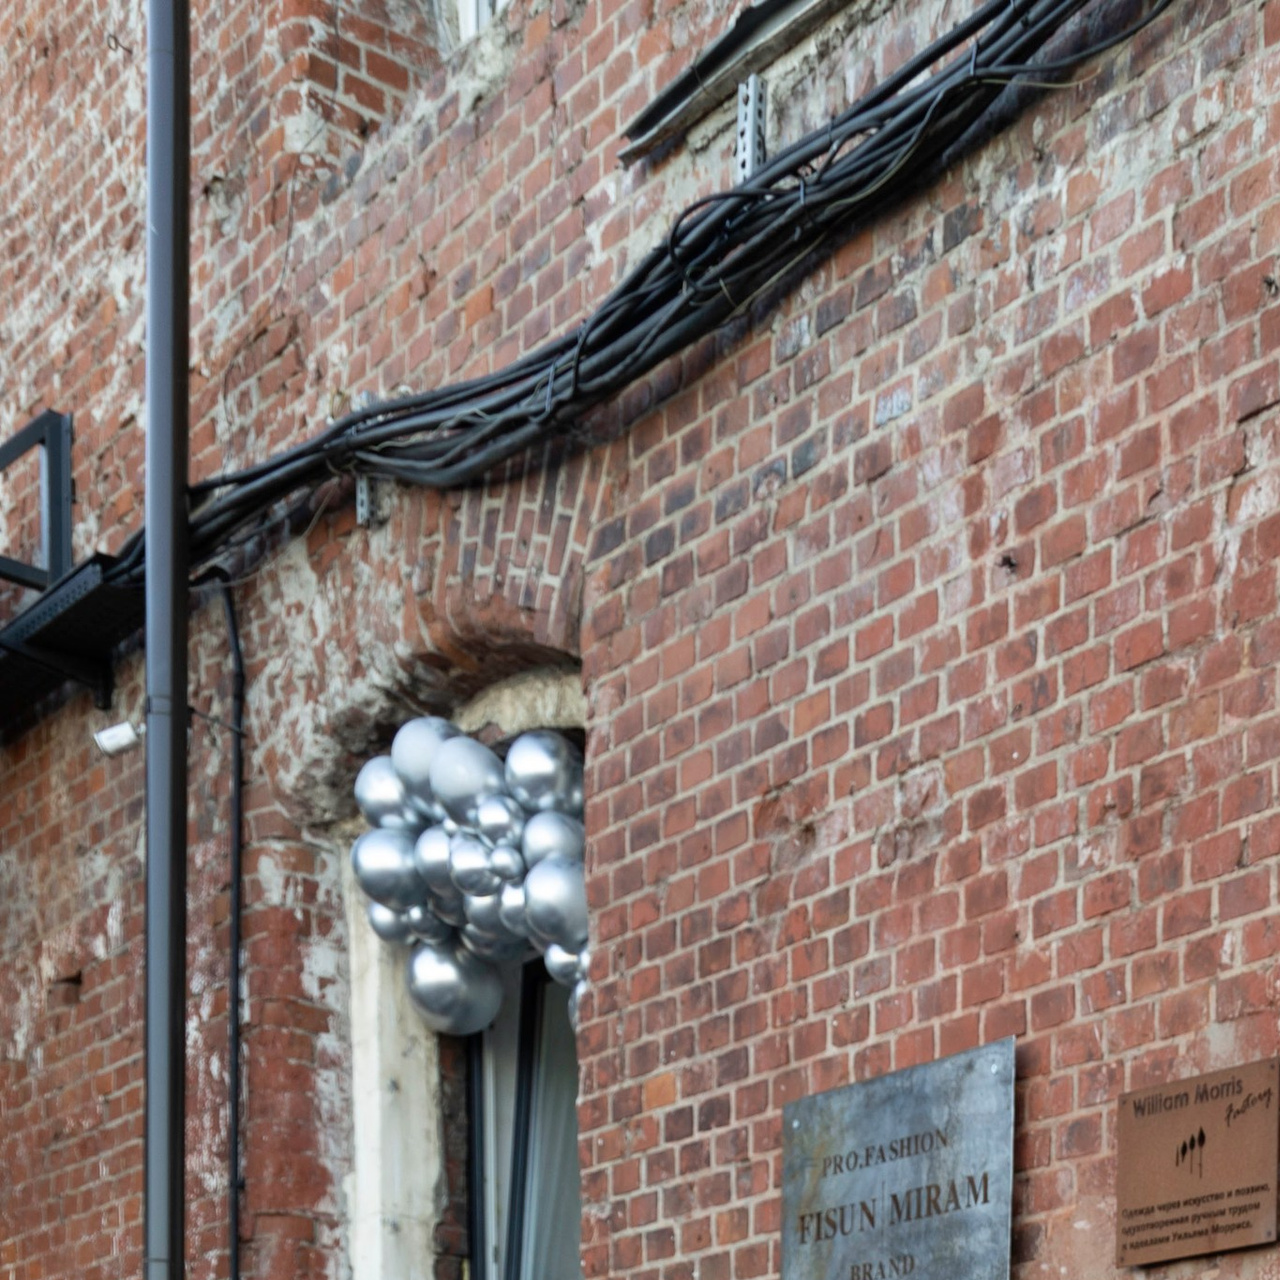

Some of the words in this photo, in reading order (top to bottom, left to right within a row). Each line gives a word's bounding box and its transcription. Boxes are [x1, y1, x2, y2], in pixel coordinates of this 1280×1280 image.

[1133, 1090, 1189, 1119] William
[1194, 1075, 1243, 1104] Morris
[821, 1127, 950, 1178] PRO.FASHION
[797, 1198, 877, 1245] FISUN
[889, 1171, 990, 1227] MIRAM
